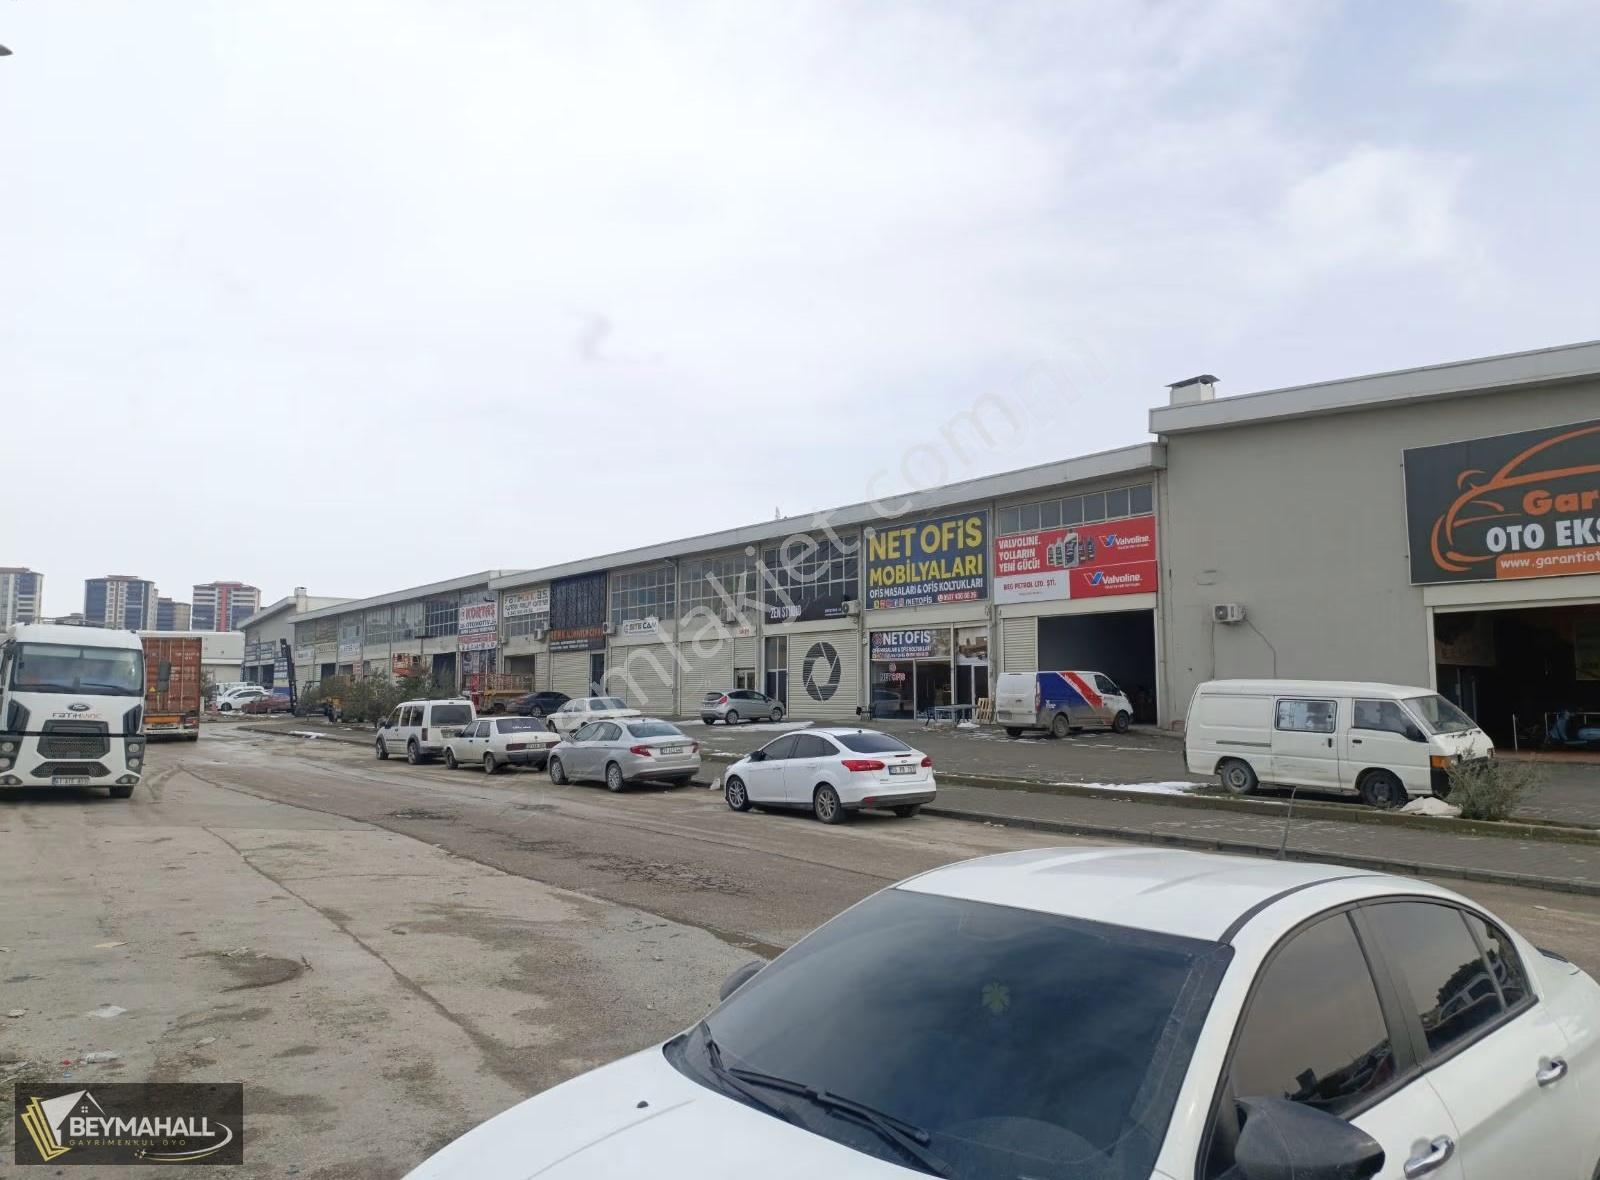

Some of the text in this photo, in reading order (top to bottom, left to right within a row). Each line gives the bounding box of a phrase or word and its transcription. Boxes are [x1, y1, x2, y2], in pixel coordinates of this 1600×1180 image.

[869, 516, 983, 562] NET OFİS
[1486, 523, 1545, 553] OTO
[998, 547, 1036, 561] YOLLARIN
[869, 554, 983, 587] MOBİLYALARI
[1102, 573, 1140, 585] Valvoline
